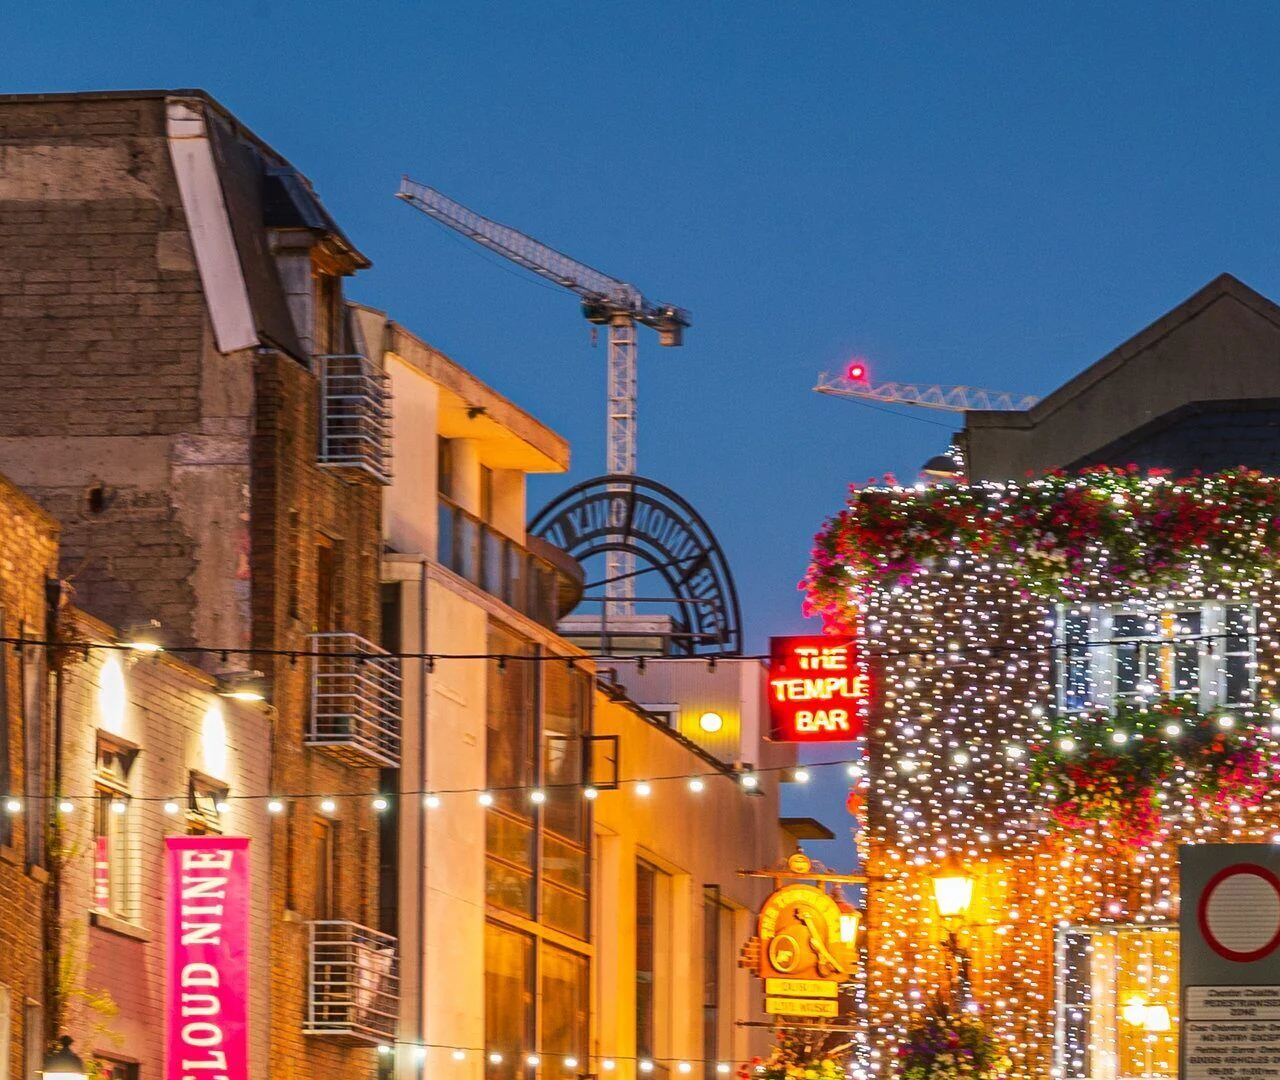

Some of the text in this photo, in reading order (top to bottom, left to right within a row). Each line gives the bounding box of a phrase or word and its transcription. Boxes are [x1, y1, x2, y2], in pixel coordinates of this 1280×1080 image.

[794, 647, 848, 670] THE
[770, 677, 869, 701] TEMPLE
[795, 709, 850, 732] BAR
[181, 850, 234, 946] NINE
